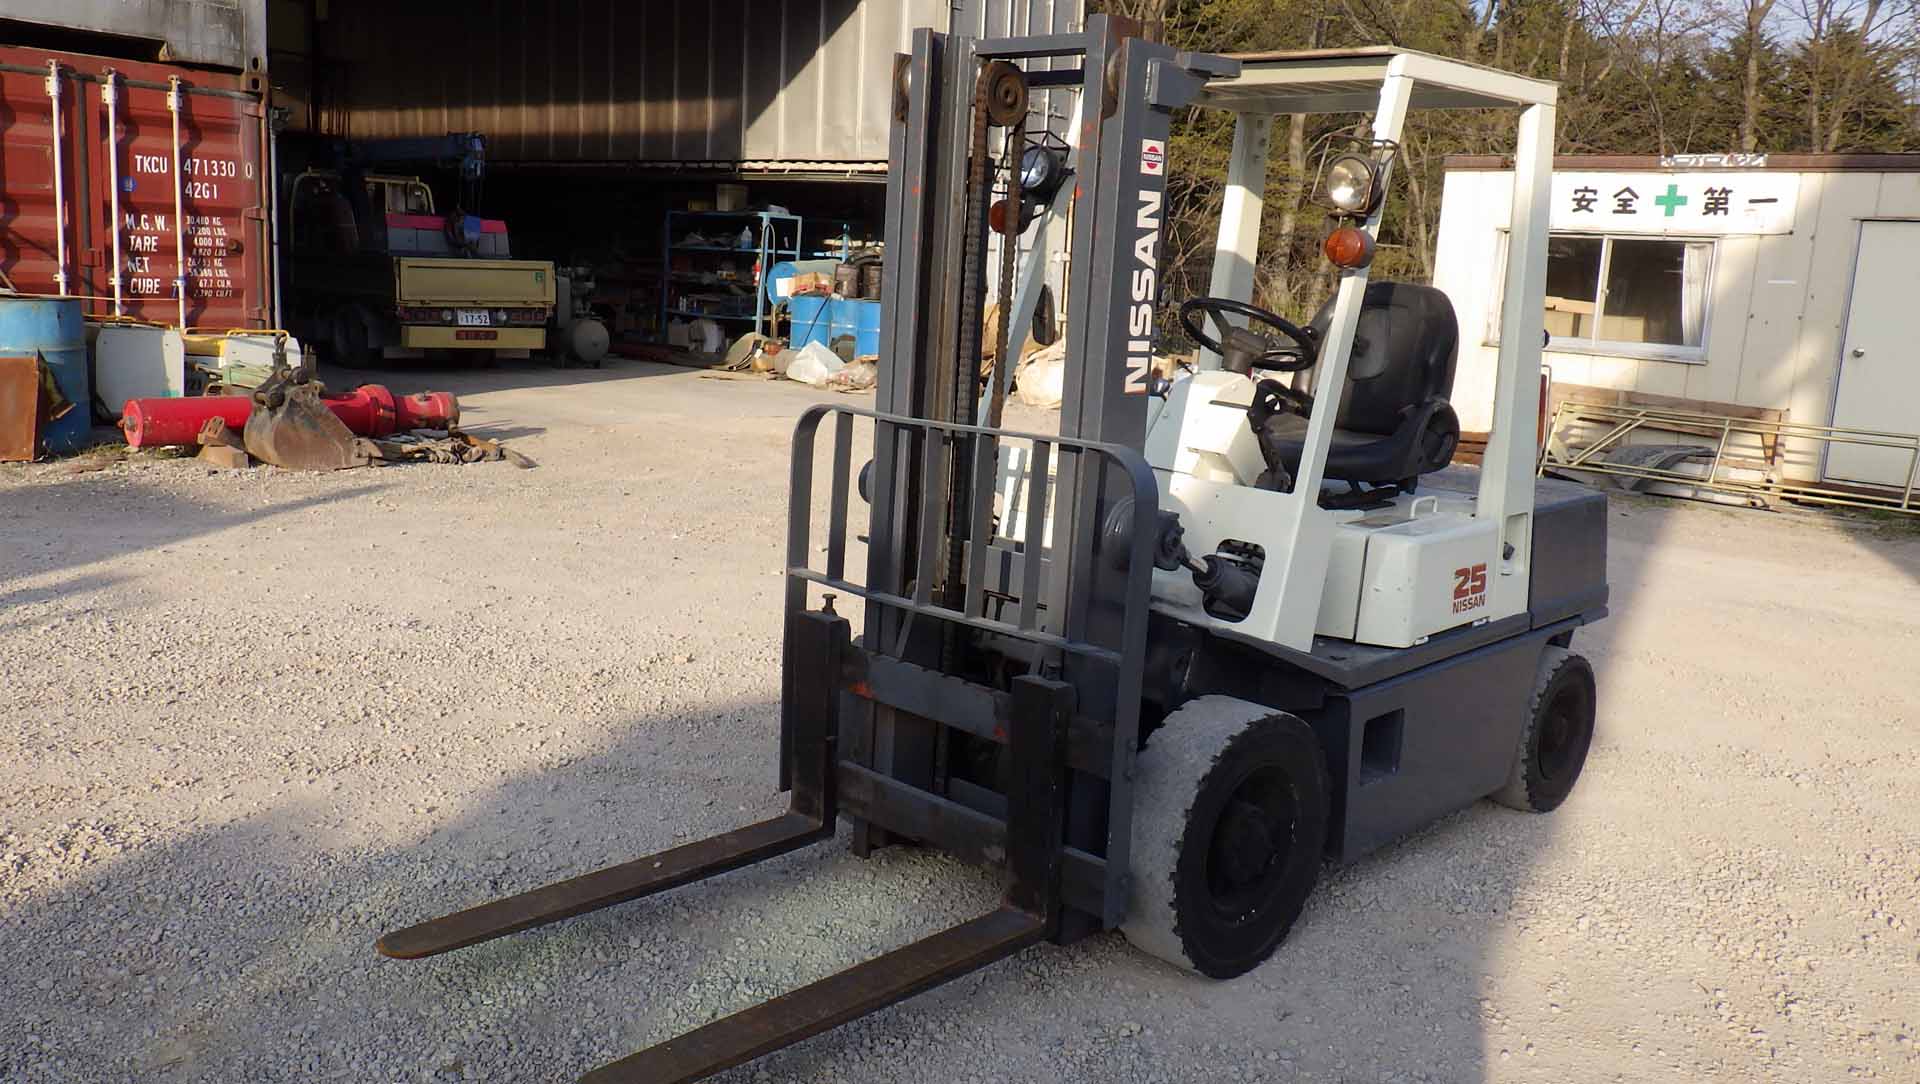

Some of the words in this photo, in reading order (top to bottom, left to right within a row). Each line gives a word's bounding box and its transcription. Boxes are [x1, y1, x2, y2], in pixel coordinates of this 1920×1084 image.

[135, 155, 168, 173] TKCU
[184, 158, 236, 177] 471330
[245, 163, 253, 179] 0
[185, 182, 218, 199] 42G1
[125, 213, 170, 232] M.G.W.
[129, 235, 158, 252] TARE
[127, 256, 150, 273] NET
[130, 278, 161, 295] CUBE
[1124, 190, 1162, 394] NISSAN
[1453, 562, 1487, 600] 25
[1452, 594, 1486, 615] NISSAN
